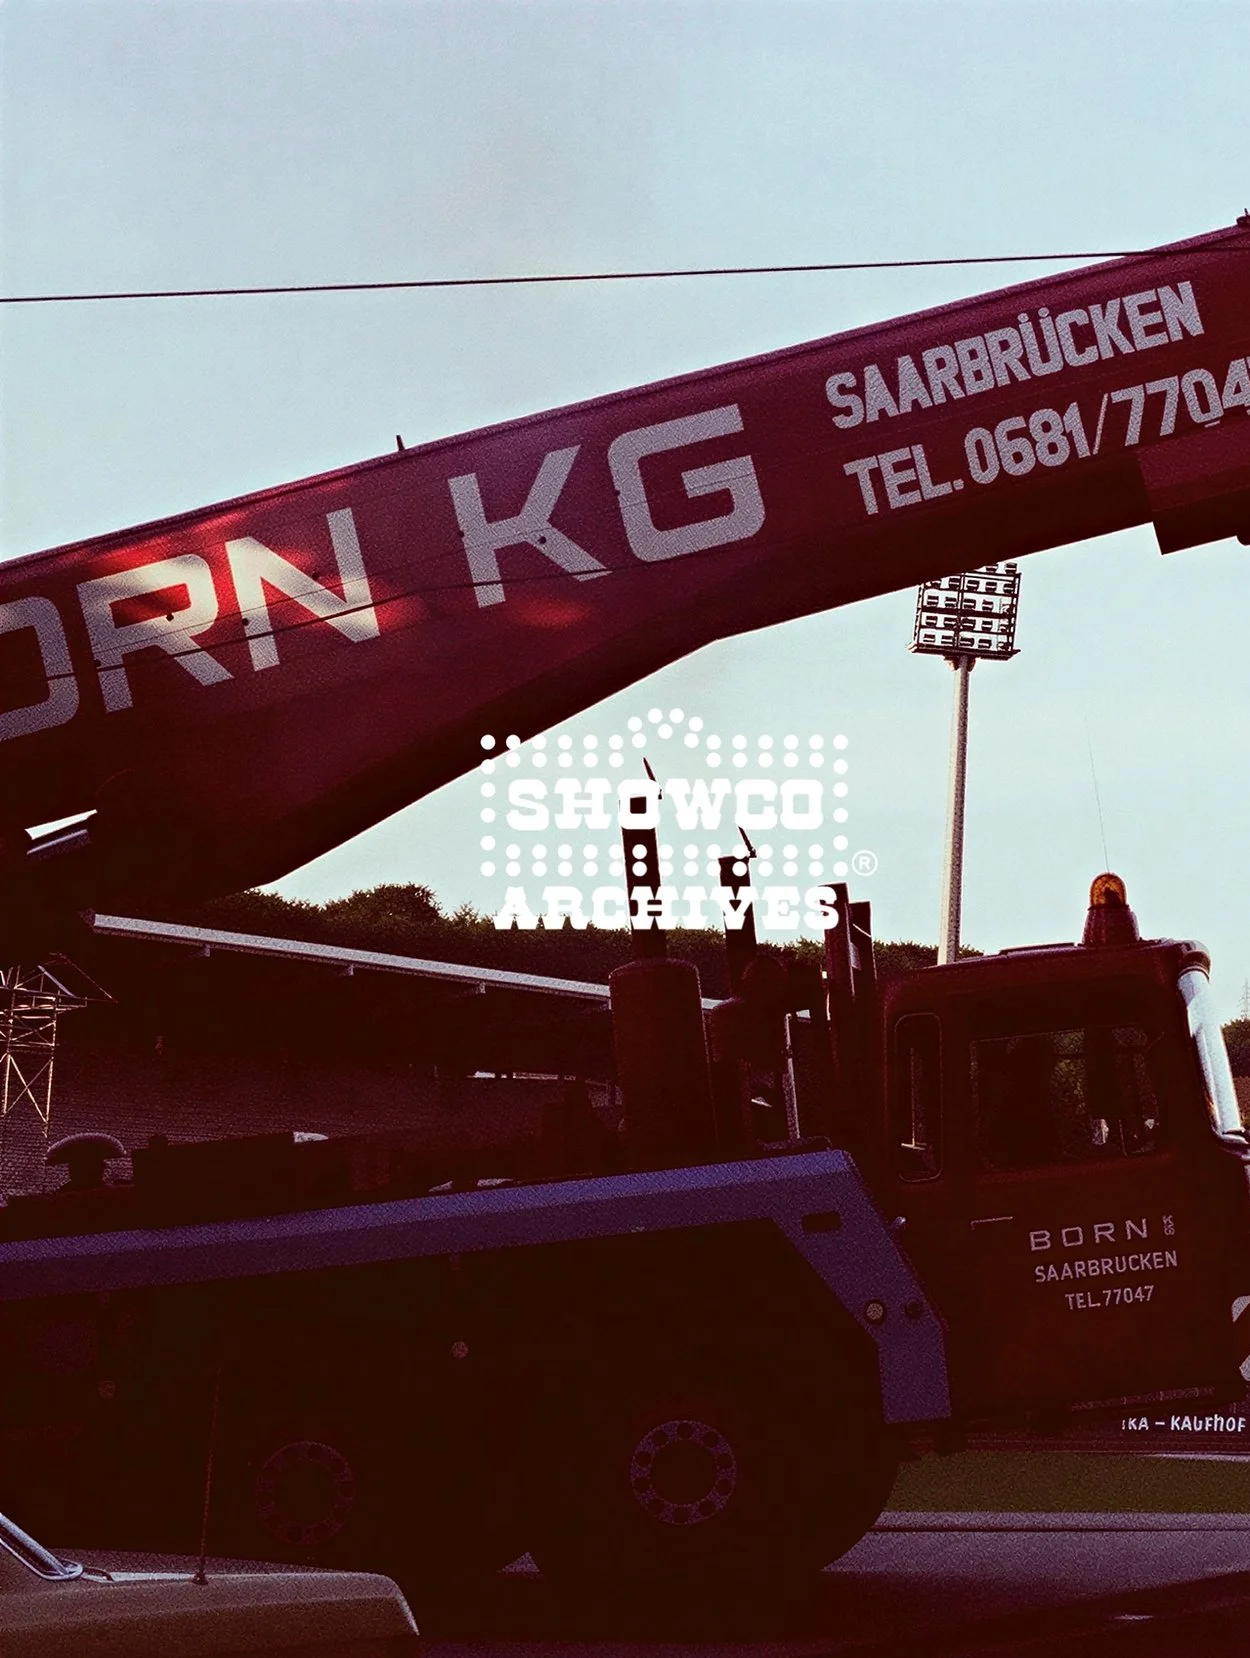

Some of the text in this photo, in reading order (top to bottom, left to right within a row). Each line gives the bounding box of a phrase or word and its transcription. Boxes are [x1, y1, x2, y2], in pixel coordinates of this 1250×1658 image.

[825, 280, 1206, 430] SAARBRÜCKEN
[447, 403, 766, 609] KG
[1029, 1218, 1148, 1252] BORN
